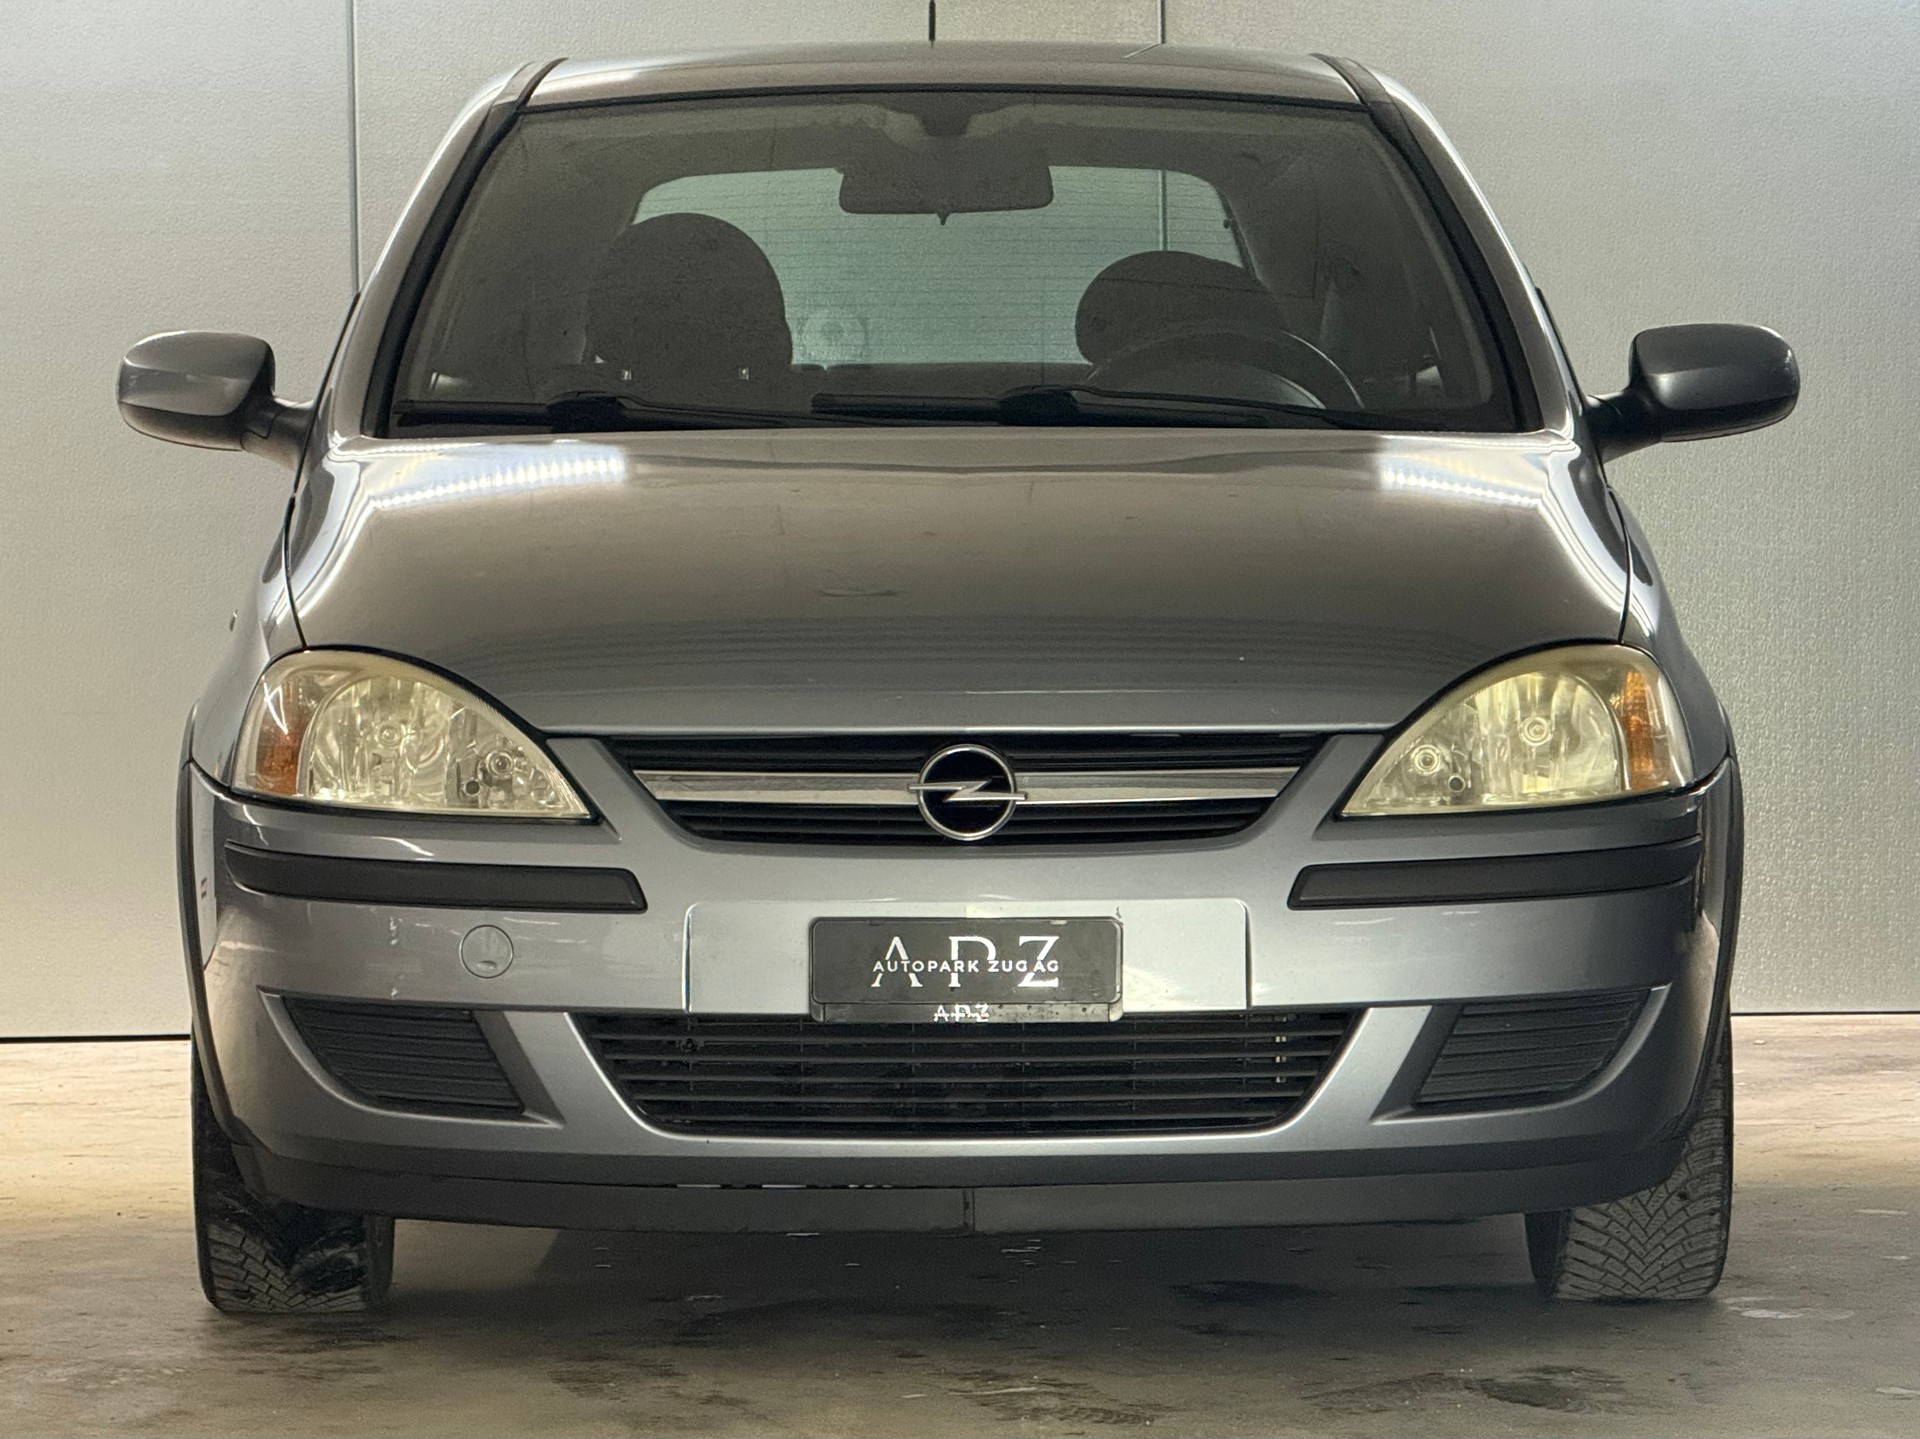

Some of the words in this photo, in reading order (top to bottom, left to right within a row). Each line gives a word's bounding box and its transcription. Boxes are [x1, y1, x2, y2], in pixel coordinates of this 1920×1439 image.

[873, 960, 980, 973] AUTOPARK
[988, 960, 1028, 973] ZUG
[1033, 960, 1060, 973] AG
